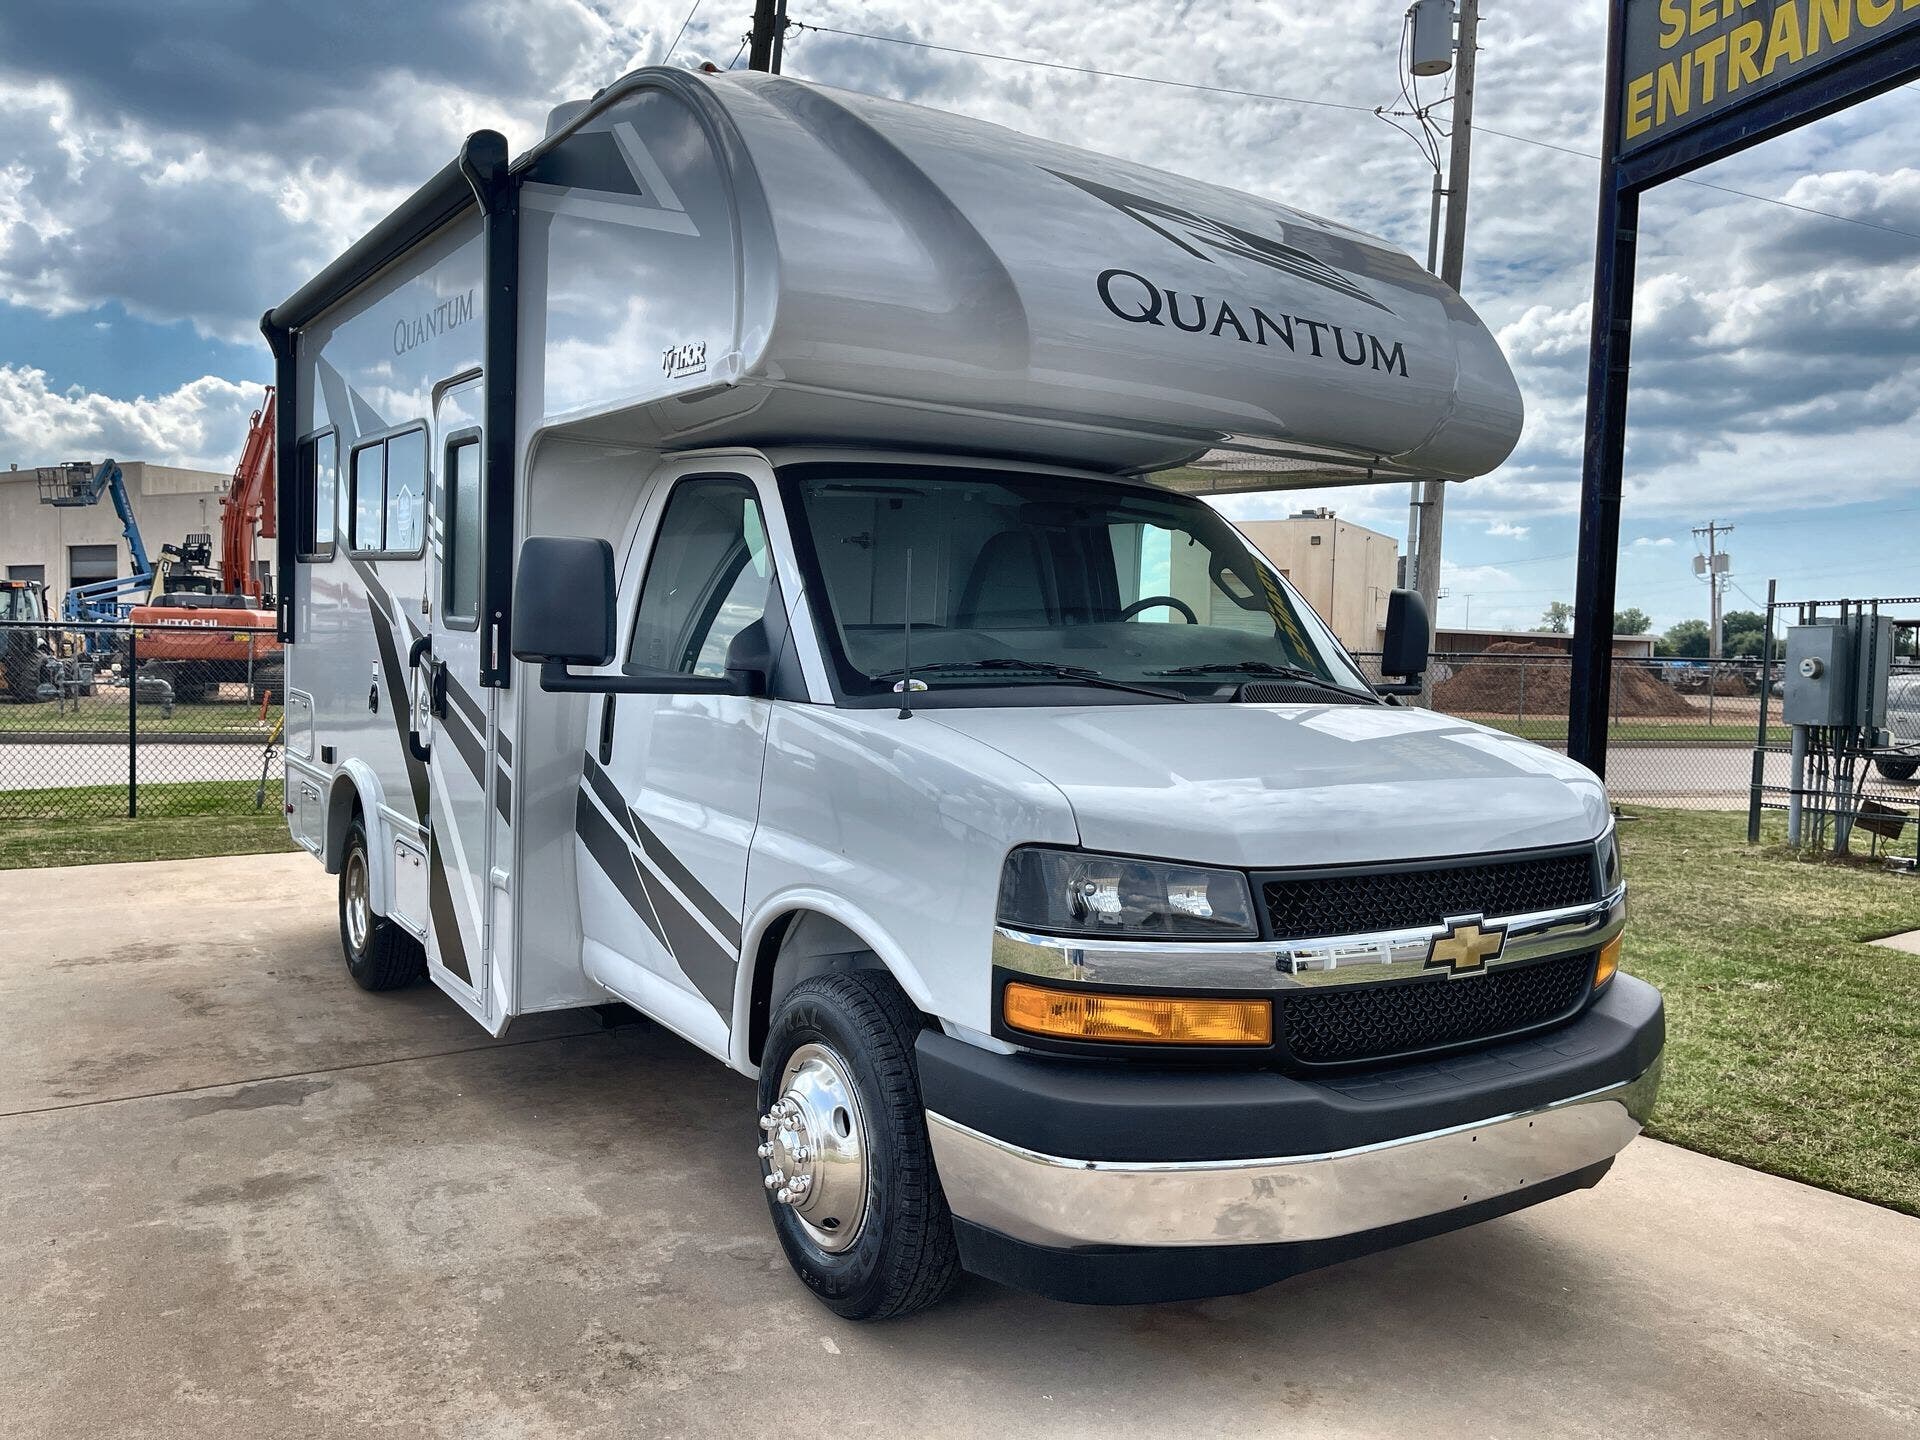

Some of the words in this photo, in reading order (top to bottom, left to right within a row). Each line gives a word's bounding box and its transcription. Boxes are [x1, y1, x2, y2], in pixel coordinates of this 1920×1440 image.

[1626, 0, 1920, 140] ENTRAN
[393, 288, 474, 356] QUANTUM
[669, 341, 706, 370] THOR
[1096, 268, 1410, 378] QUANTUM
